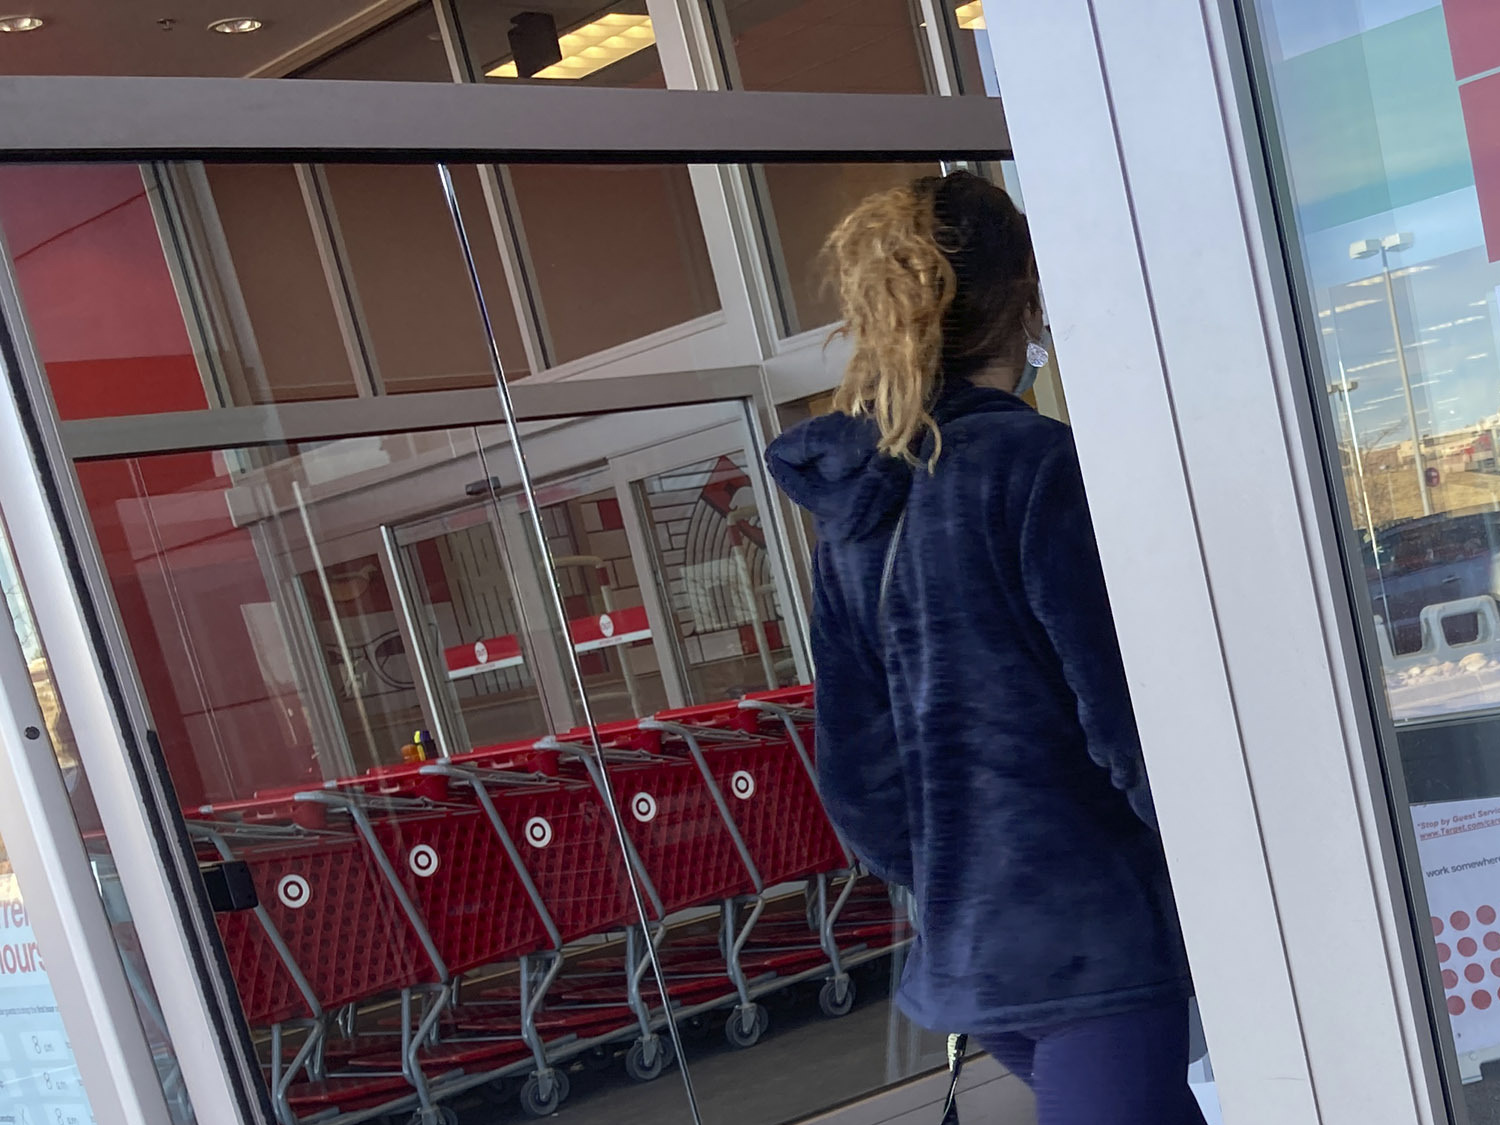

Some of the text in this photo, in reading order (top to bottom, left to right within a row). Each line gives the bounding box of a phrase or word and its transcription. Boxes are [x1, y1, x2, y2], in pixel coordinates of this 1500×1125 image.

[1440, 818, 1450, 827] by
[1452, 813, 1476, 823] Guest
[1426, 866, 1449, 878] work
